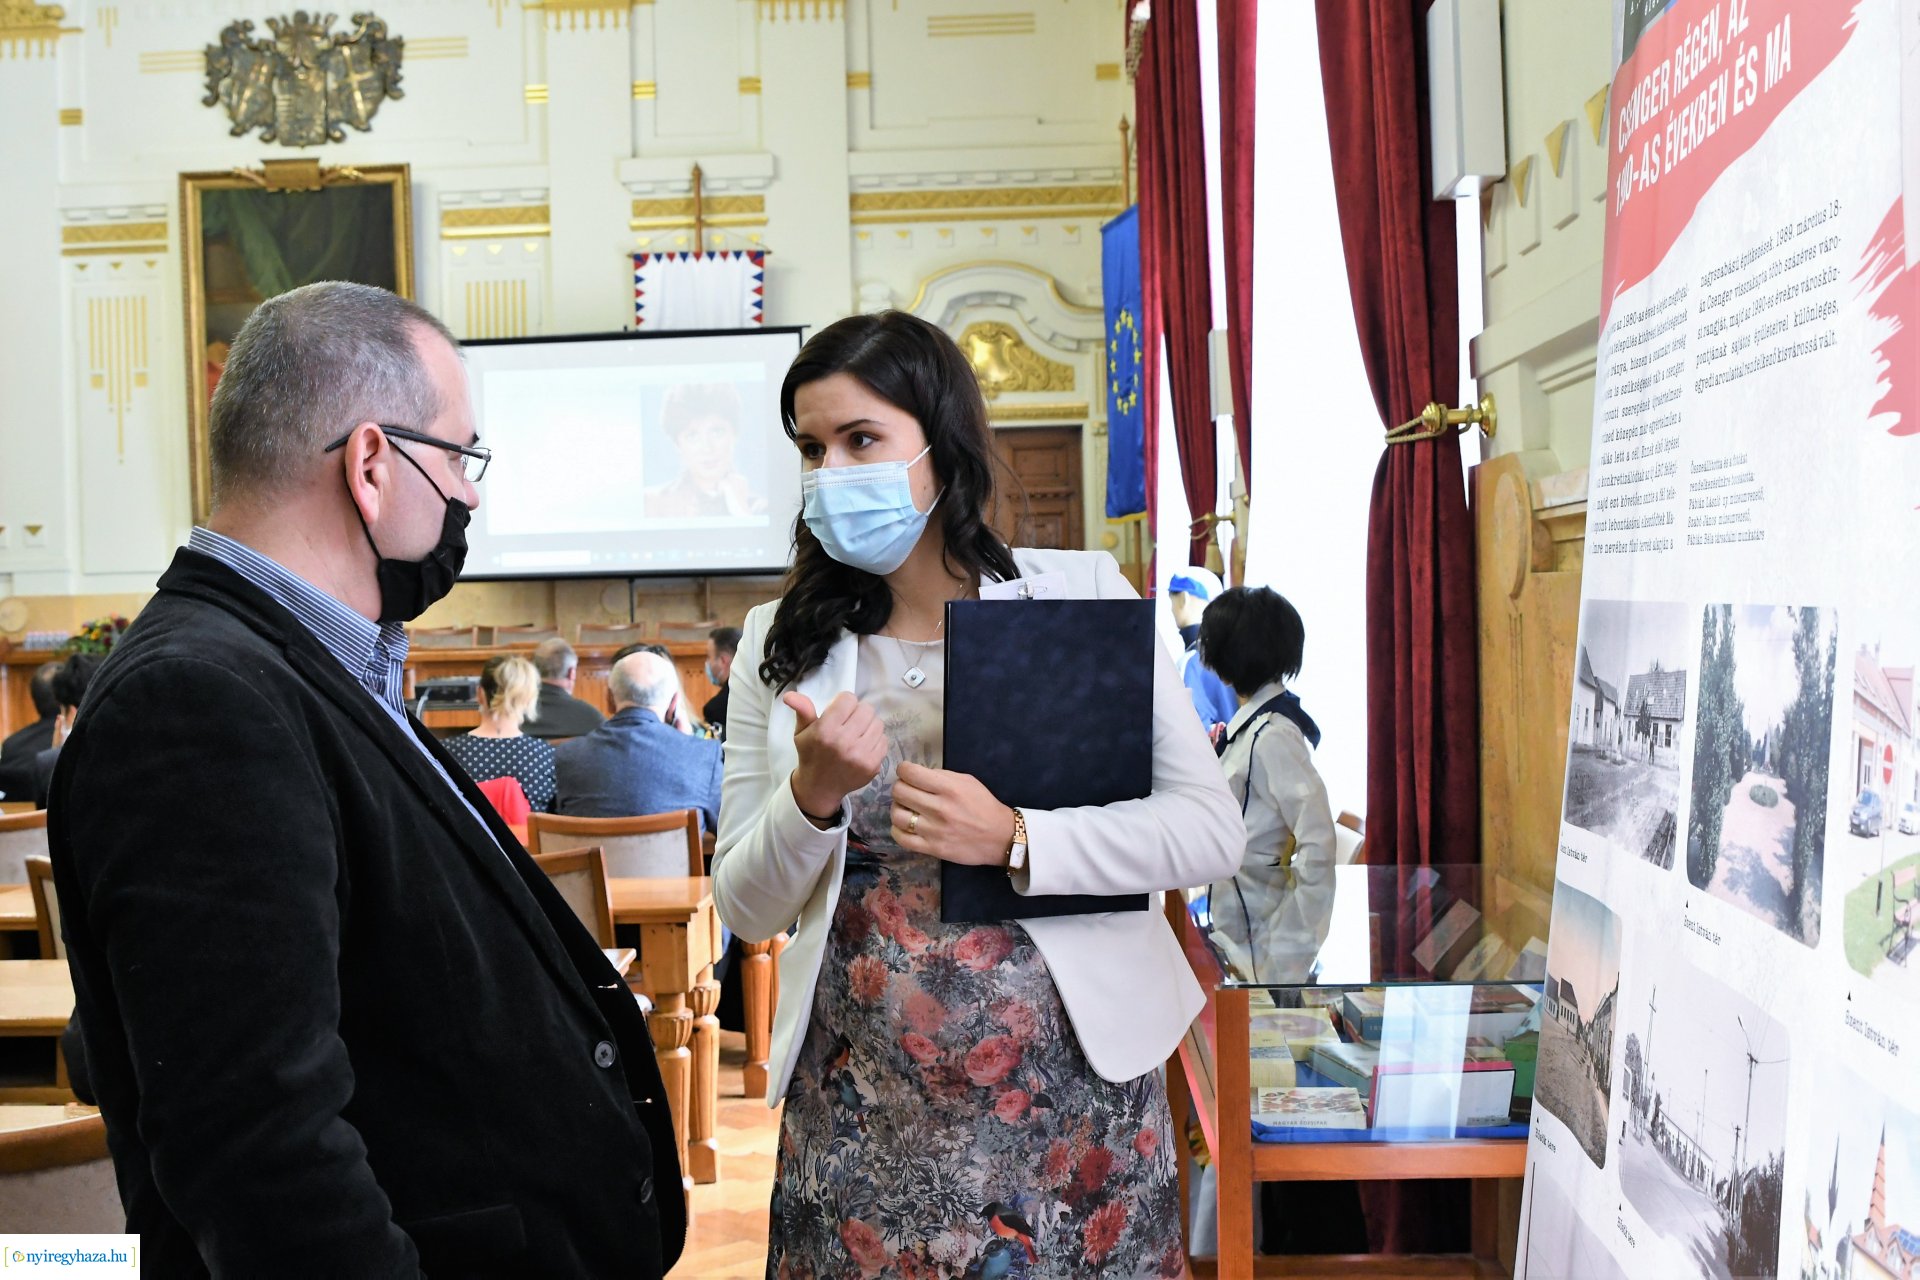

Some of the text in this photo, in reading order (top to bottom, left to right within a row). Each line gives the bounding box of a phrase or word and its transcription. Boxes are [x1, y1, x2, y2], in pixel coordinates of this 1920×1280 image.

[1673, 2, 1723, 99] RÉGEN,
[1726, 0, 1749, 45] AZ
[1664, 67, 1728, 176] ÉVEKBEN
[1733, 40, 1758, 116] ÉS
[1764, 12, 1791, 93] MA
[1776, 223, 1795, 248] 1989.
[1796, 209, 1827, 236] március
[1828, 199, 1842, 220] 18-
[1707, 288, 1733, 310] Csenger
[1784, 244, 1817, 272] százéves
[1818, 235, 1842, 255] váro-
[1775, 282, 1799, 305] évekre
[1800, 265, 1841, 294] városköz-
[1694, 372, 1714, 394] egyedi
[1777, 333, 1818, 363] kisvárossá
[1696, 341, 1727, 369] pontjának
[1793, 299, 1839, 328] különleges,
